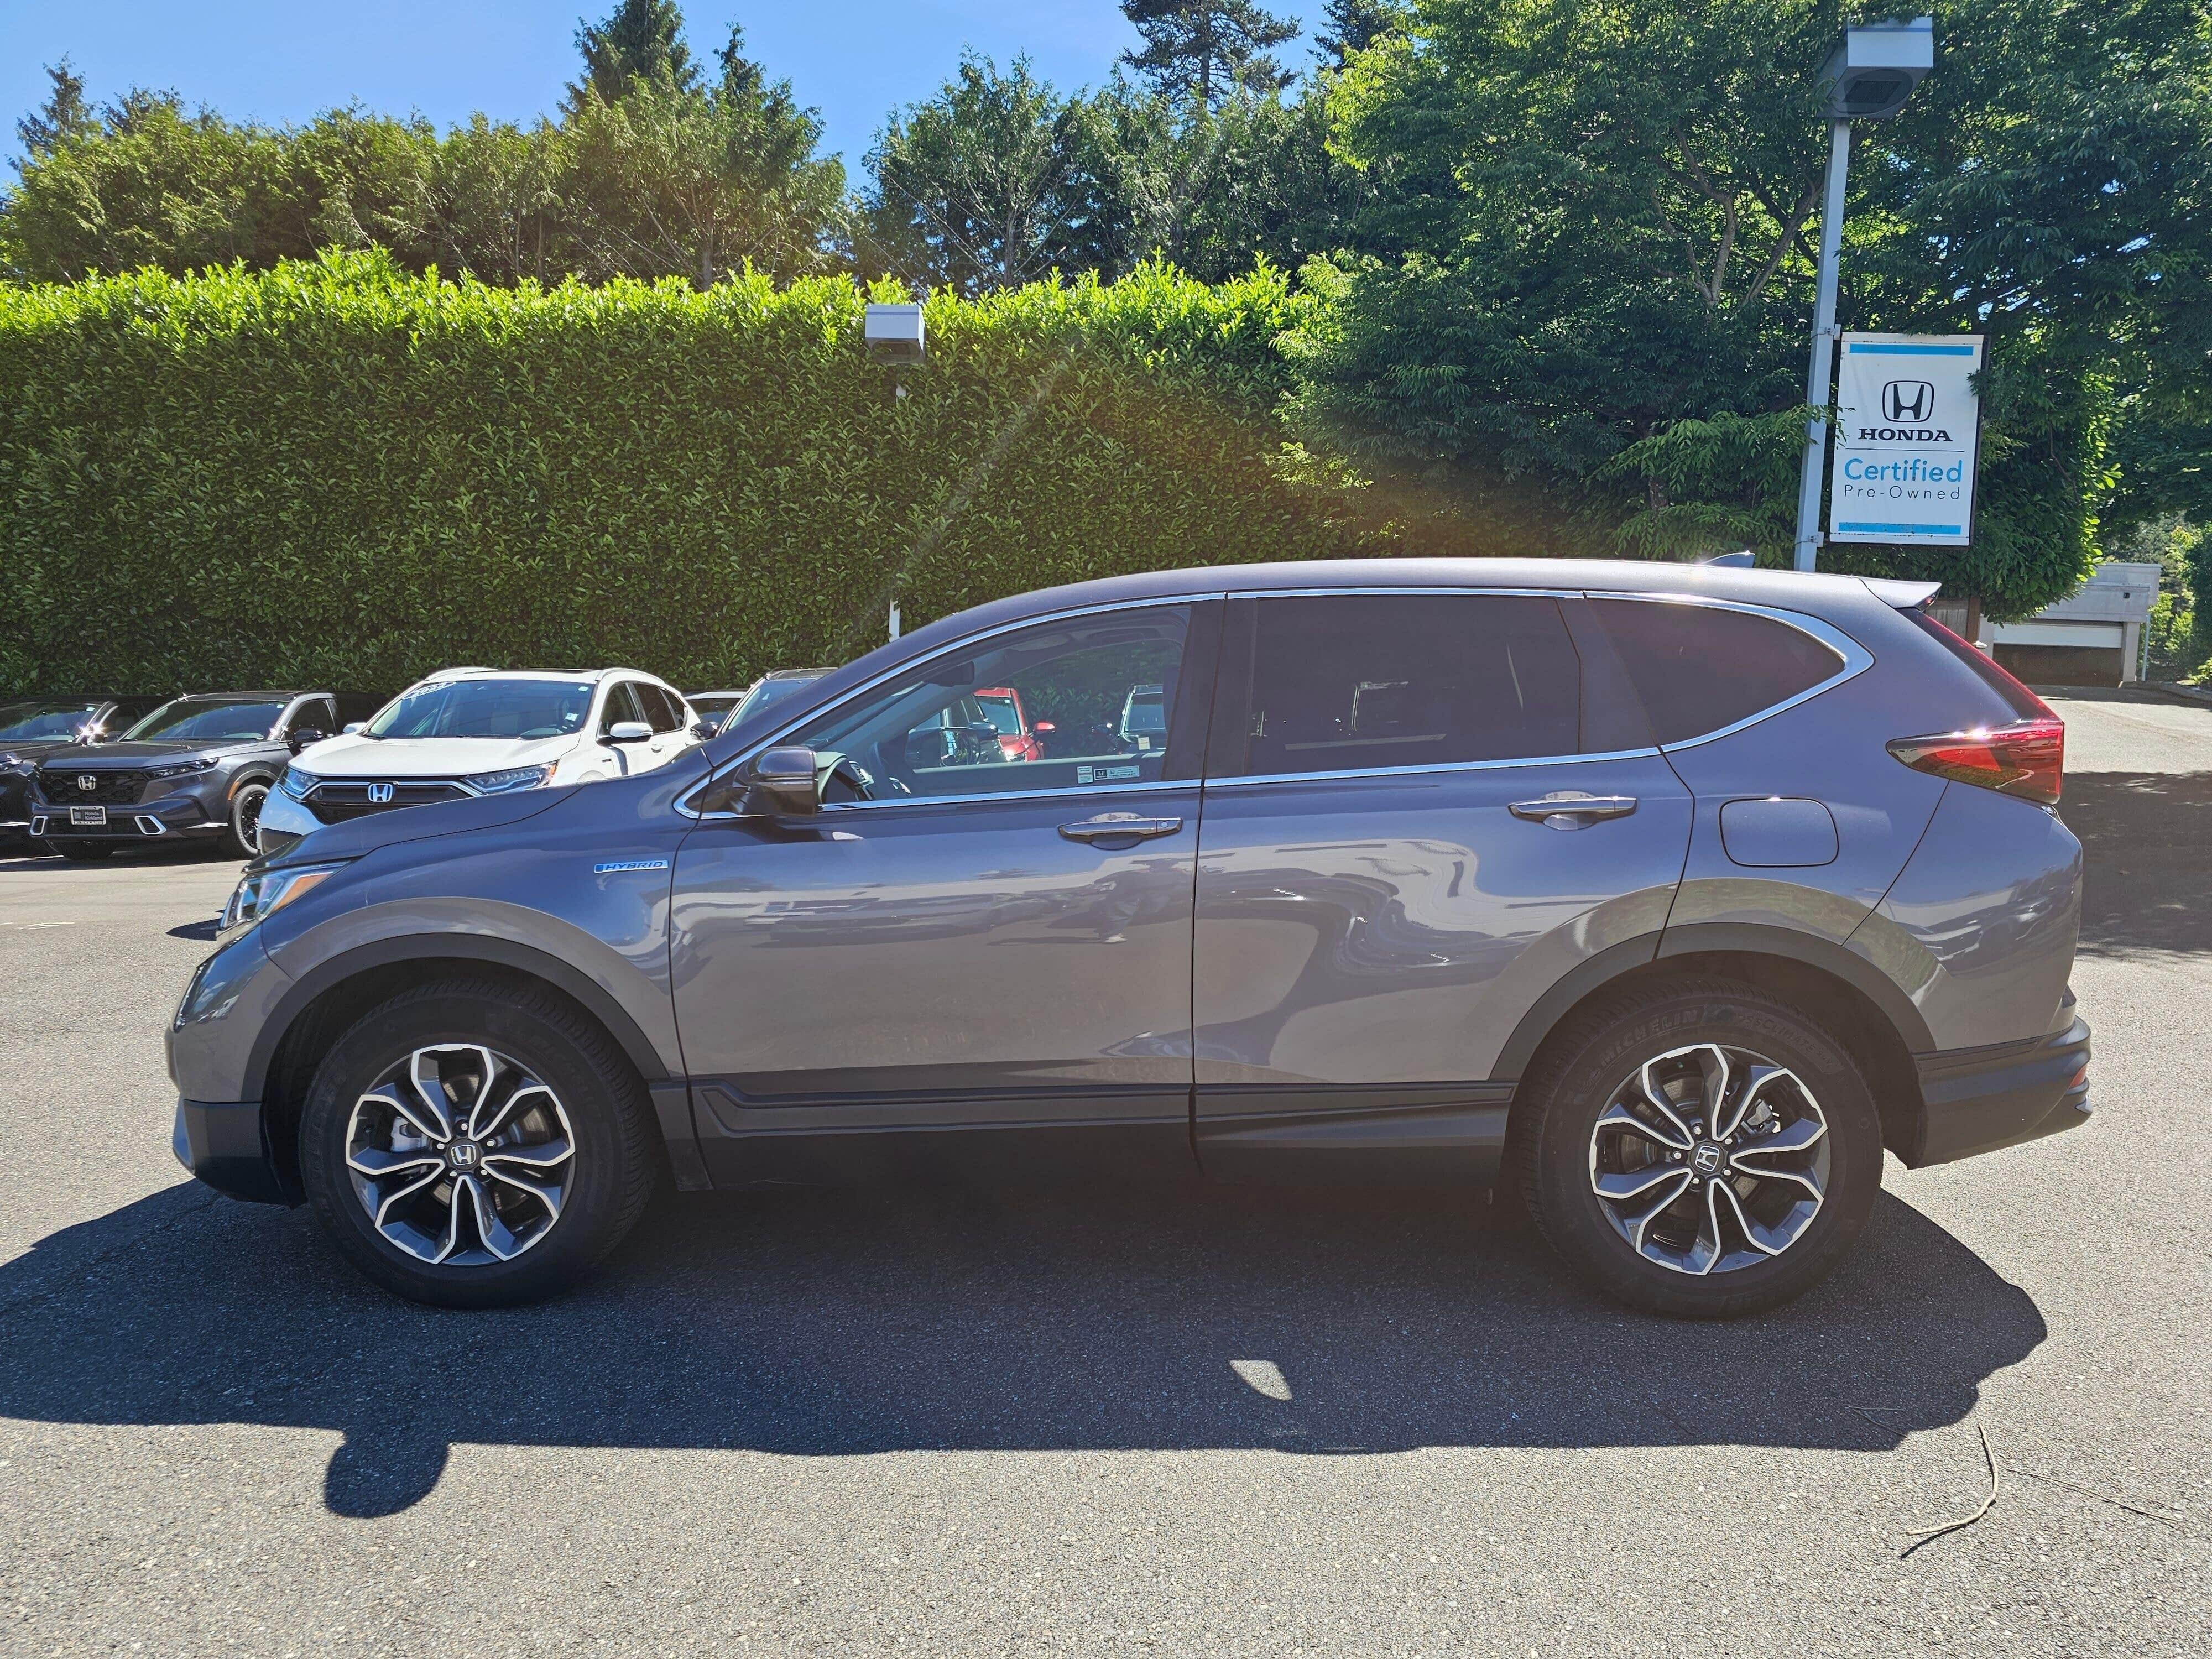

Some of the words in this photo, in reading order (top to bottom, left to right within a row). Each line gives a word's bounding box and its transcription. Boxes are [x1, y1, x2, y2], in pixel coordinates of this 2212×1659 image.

[1858, 429, 1953, 441] HONDA
[1844, 458, 1963, 482] Certified
[1844, 485, 1960, 500] Pre-Owned
[606, 862, 664, 871] HYBRID
[1600, 1009, 1698, 1067] MICHELIN
